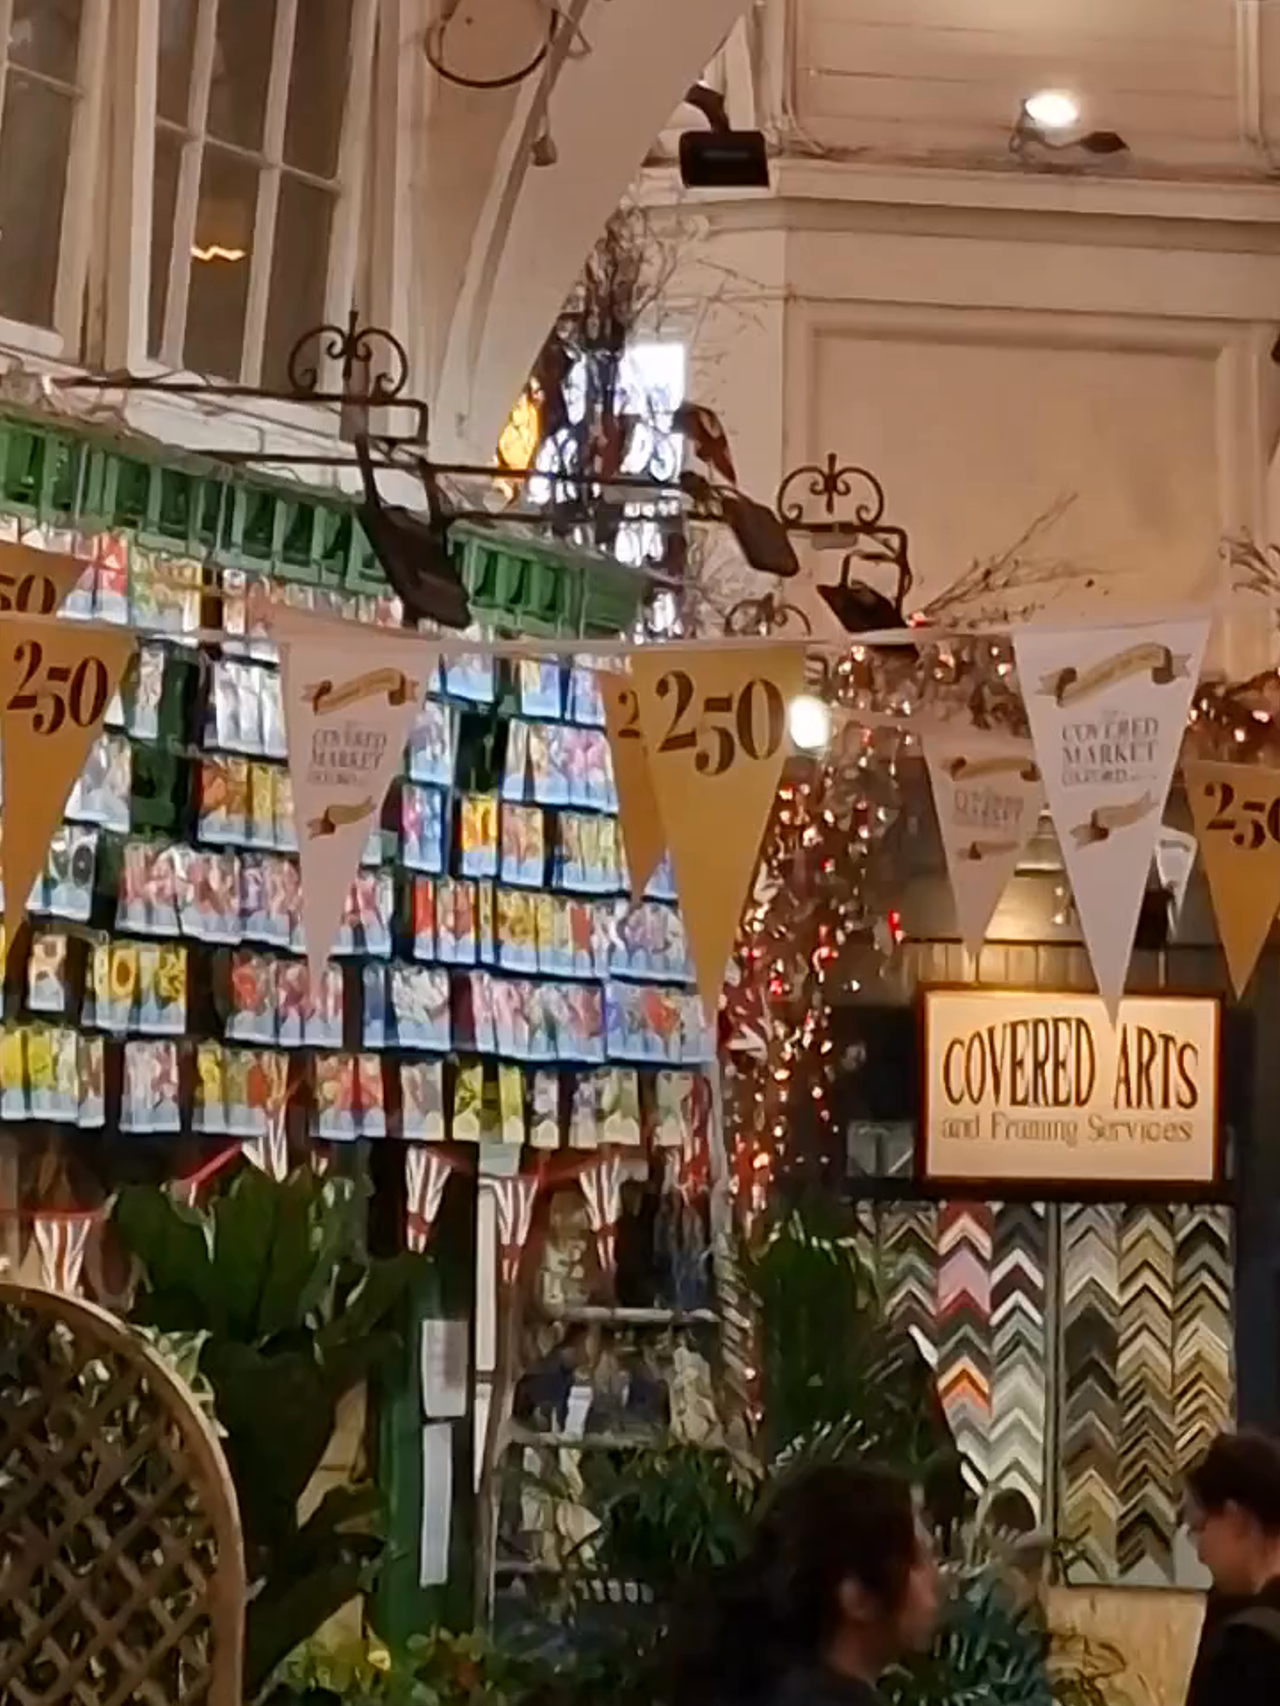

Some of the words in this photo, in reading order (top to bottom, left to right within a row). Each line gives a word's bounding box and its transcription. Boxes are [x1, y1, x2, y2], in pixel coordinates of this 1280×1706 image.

[6, 639, 109, 736] 250
[655, 669, 785, 776] 250
[1062, 740, 1157, 765] MARKET
[942, 1017, 1096, 1108] COVERED
[1113, 1022, 1199, 1110] ARTS
[941, 1115, 981, 1140] and
[990, 1111, 1078, 1148] Framing
[1087, 1114, 1194, 1142] Services
